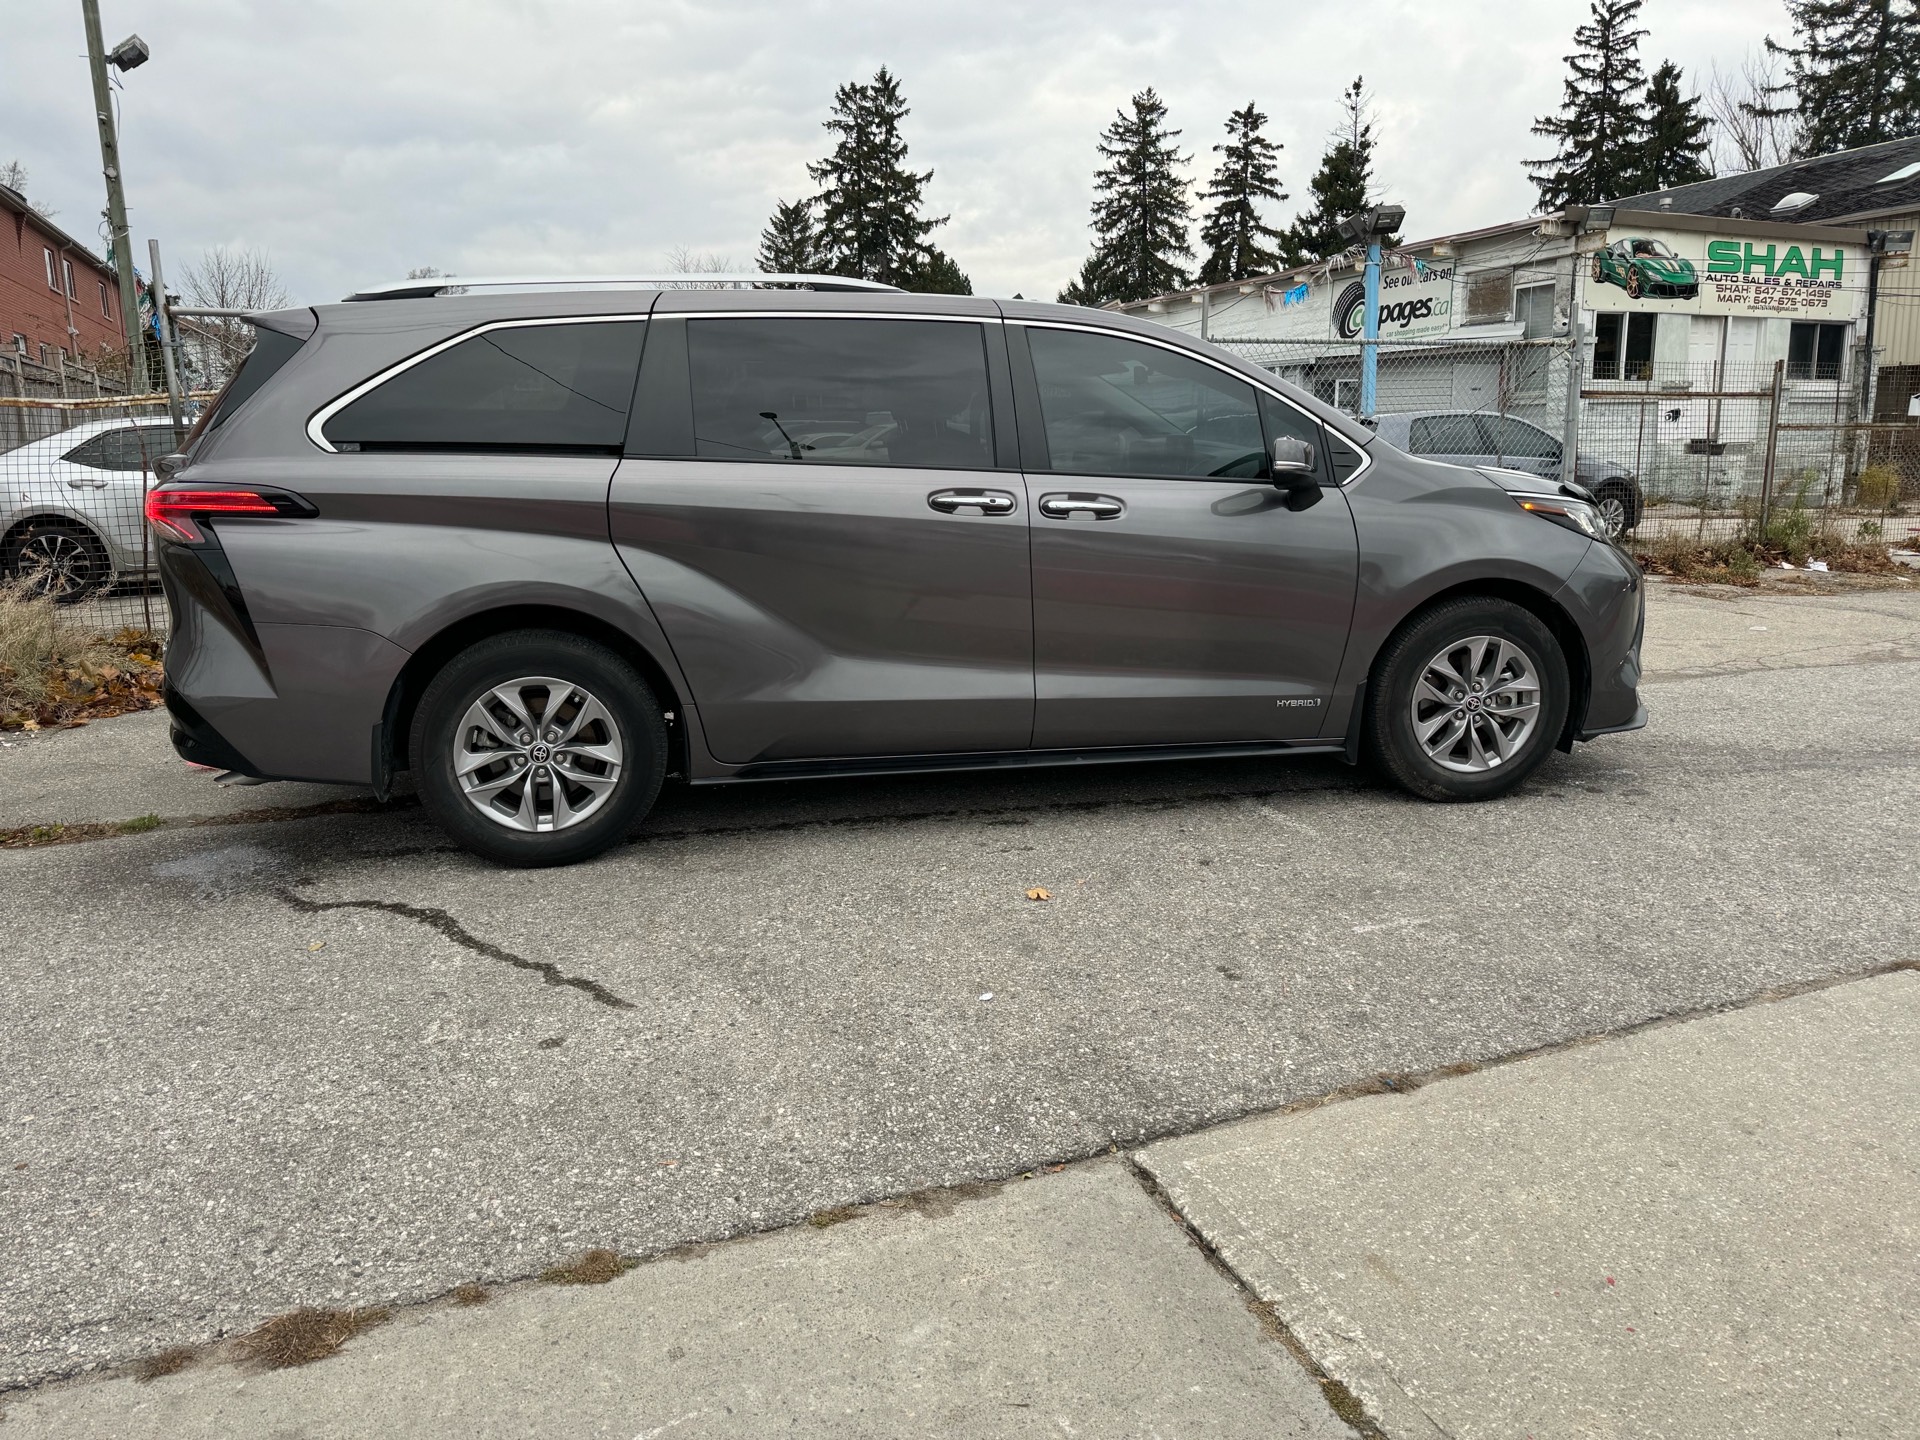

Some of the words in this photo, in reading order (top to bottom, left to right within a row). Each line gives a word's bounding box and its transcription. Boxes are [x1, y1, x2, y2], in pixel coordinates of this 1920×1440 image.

[1708, 240, 1843, 280] SHAH
[1383, 275, 1400, 290] See
[1401, 275, 1415, 286] ou
[1419, 269, 1438, 283] ars
[1440, 267, 1452, 279] on
[1705, 273, 1739, 283] AUTO
[1742, 276, 1780, 286] SALES
[1784, 278, 1792, 287] &
[1795, 278, 1843, 289] REPAIRS
[1715, 284, 1751, 294] SHAH:
[1754, 286, 1832, 298] 647-674-1496
[1717, 293, 1750, 303] MARY:
[1753, 296, 1828, 308] 647-675-0673
[1394, 328, 1416, 337] shopping
